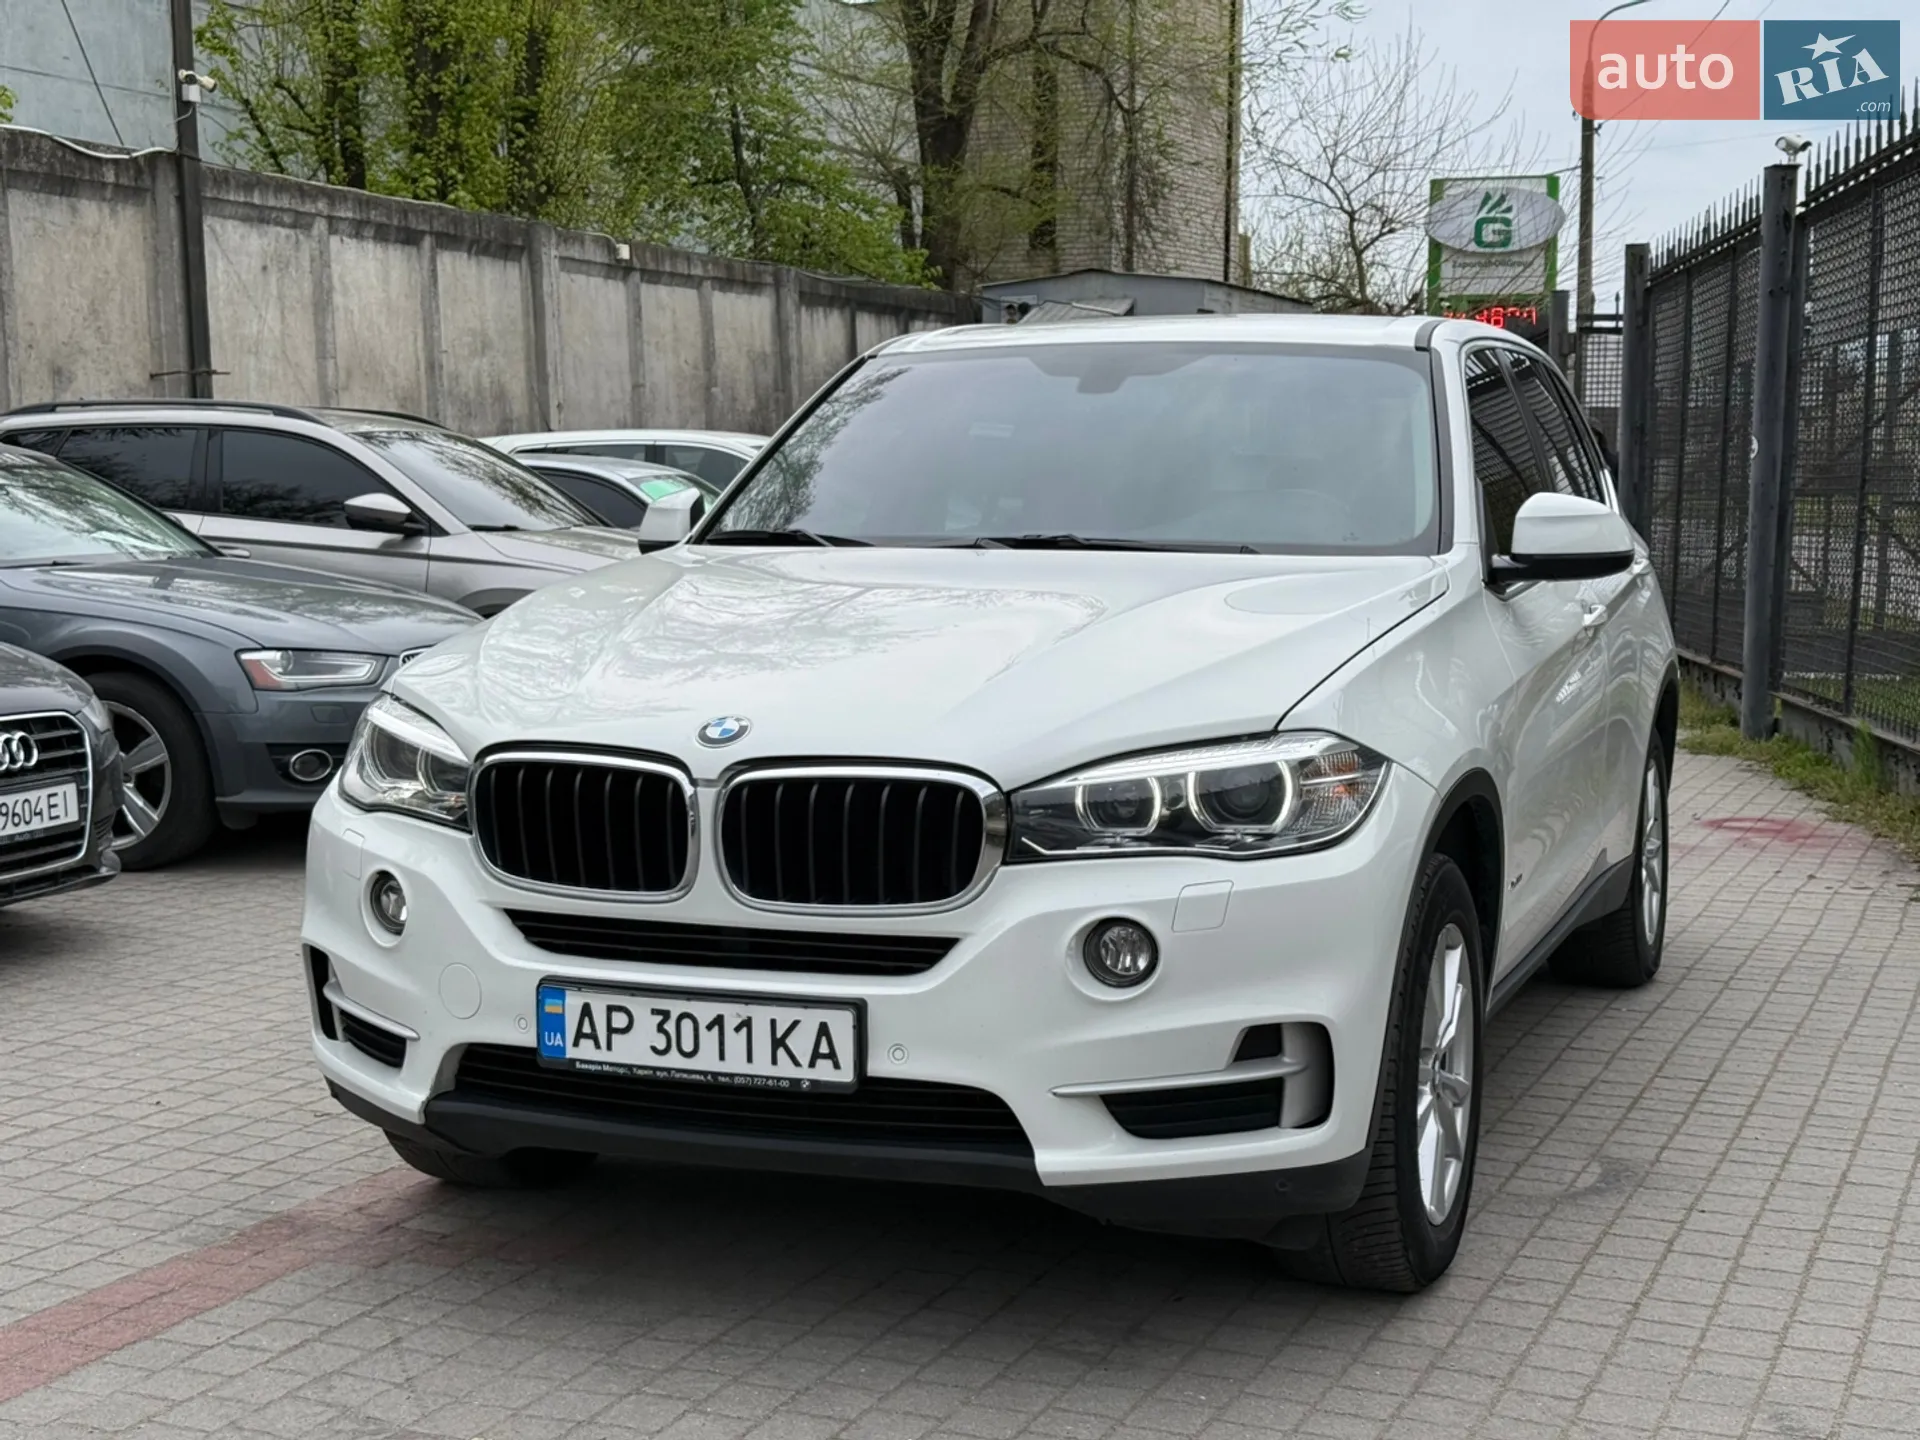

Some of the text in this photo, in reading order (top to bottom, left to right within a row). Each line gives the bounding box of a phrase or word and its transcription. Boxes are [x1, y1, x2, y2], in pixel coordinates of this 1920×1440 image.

[544, 1031, 563, 1047] UA
[572, 1001, 842, 1070] AP 3011 KA
